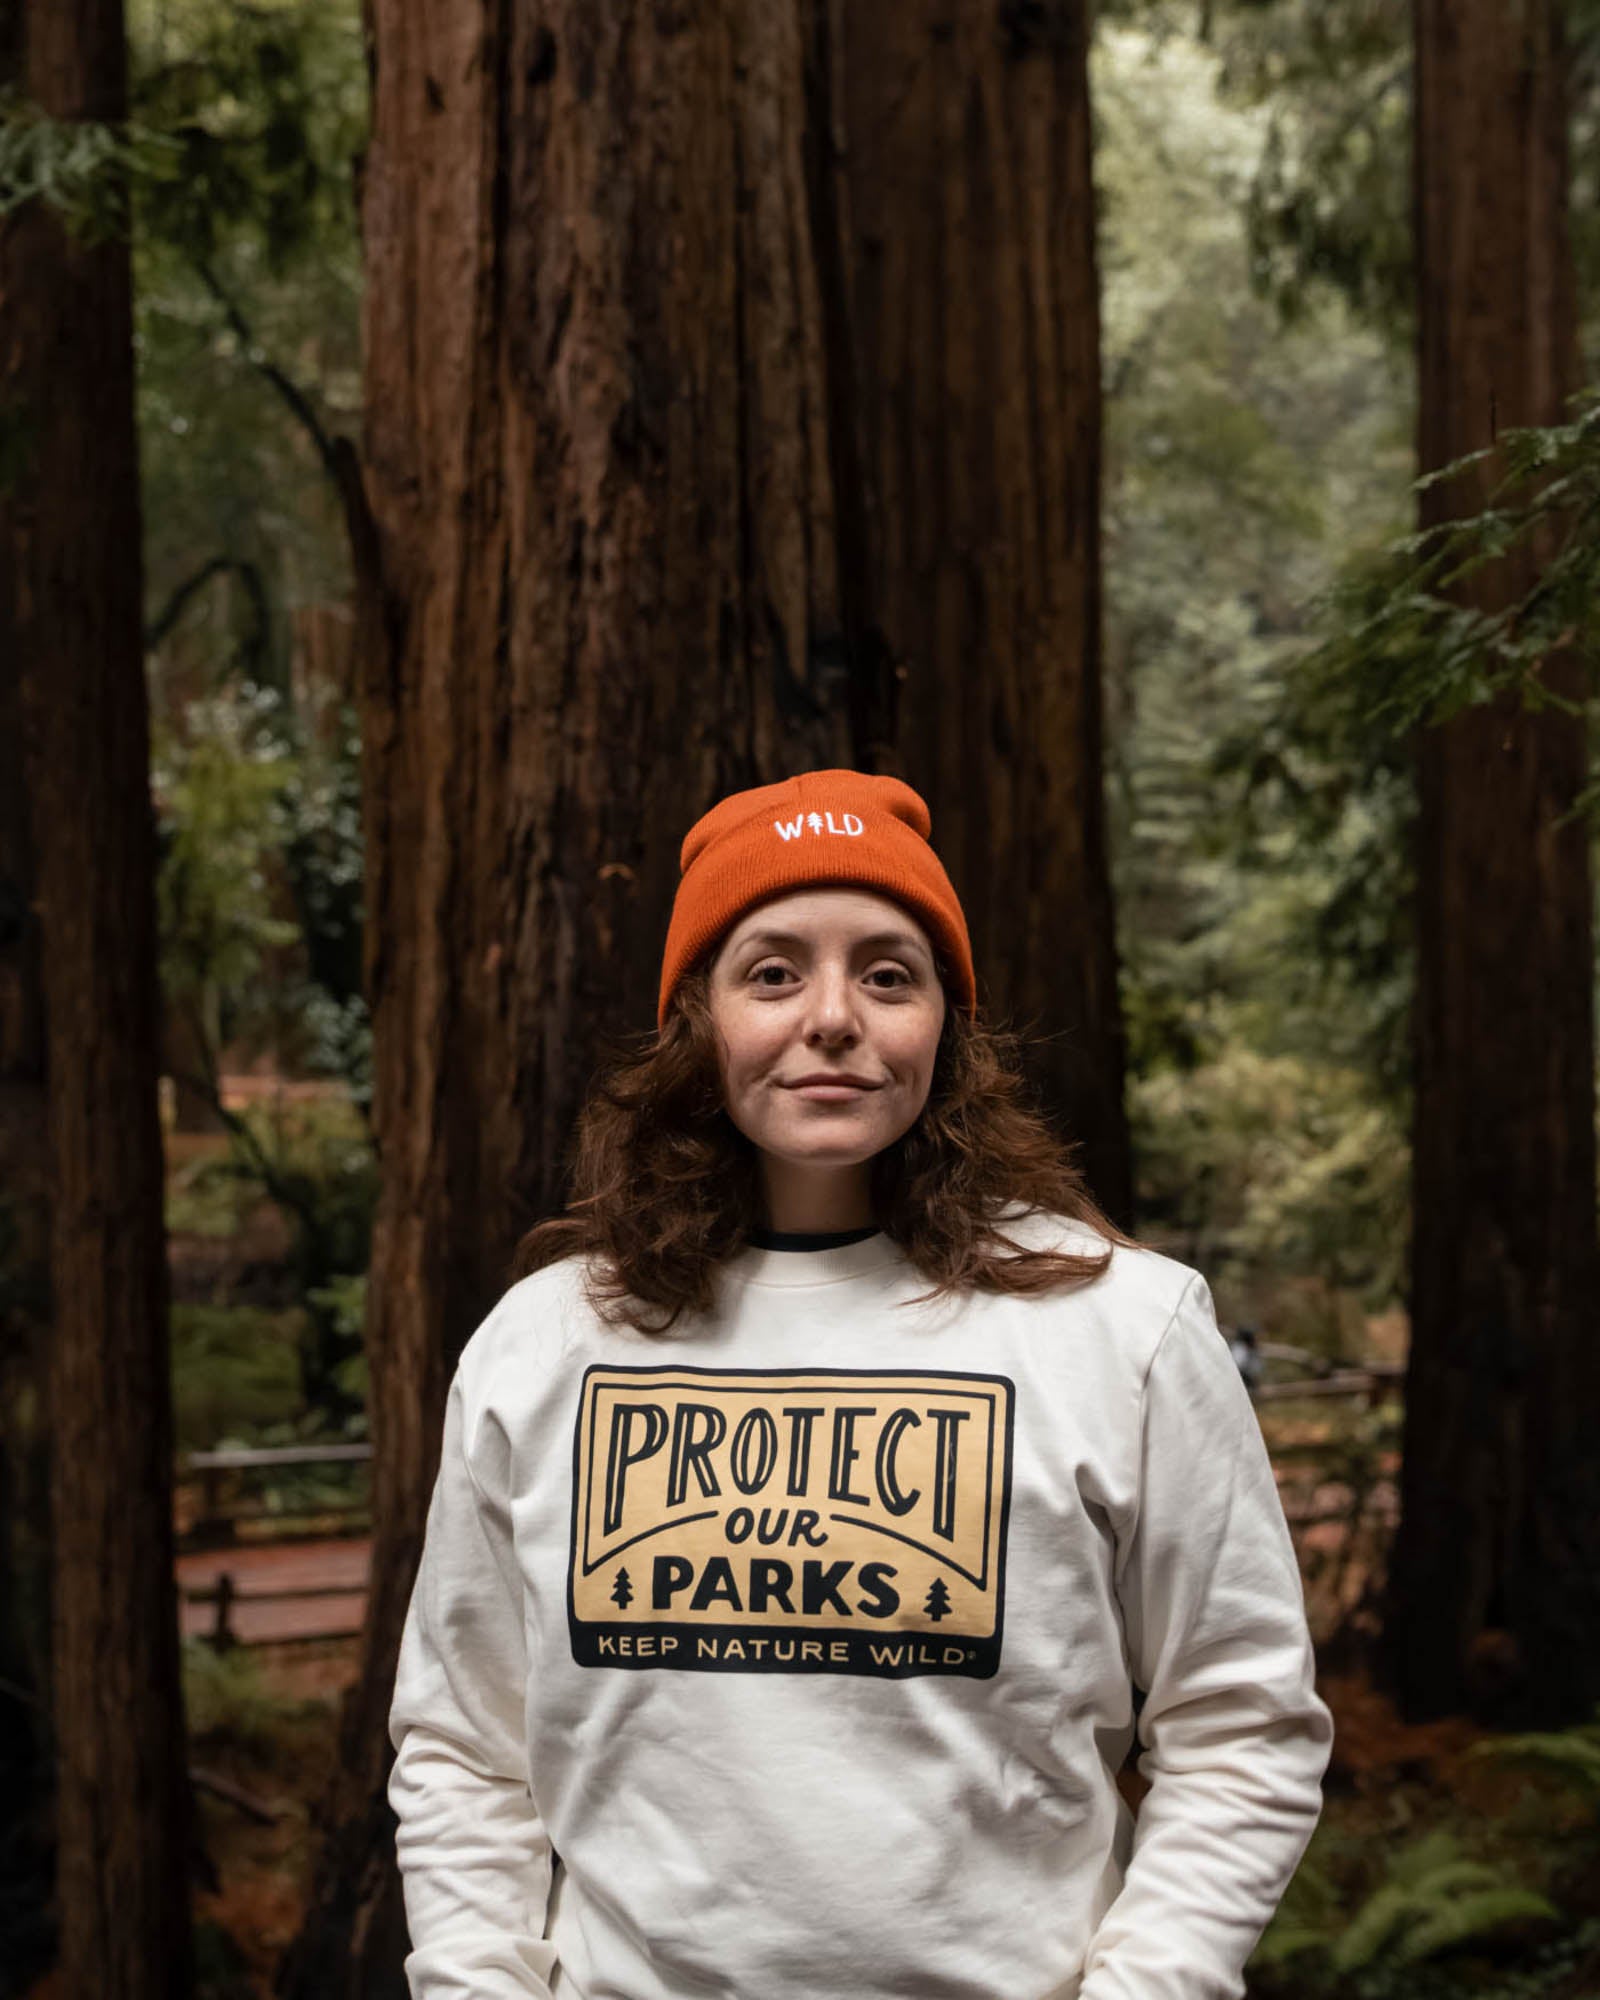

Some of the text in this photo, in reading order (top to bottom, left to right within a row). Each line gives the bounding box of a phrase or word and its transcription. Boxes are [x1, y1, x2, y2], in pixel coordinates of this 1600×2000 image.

[603, 1402, 971, 1542] PROTECT
[724, 1507, 828, 1547] OUR
[652, 1556, 900, 1618] PARKS
[599, 1636, 678, 1657] KEEP
[697, 1639, 849, 1662] NATURE
